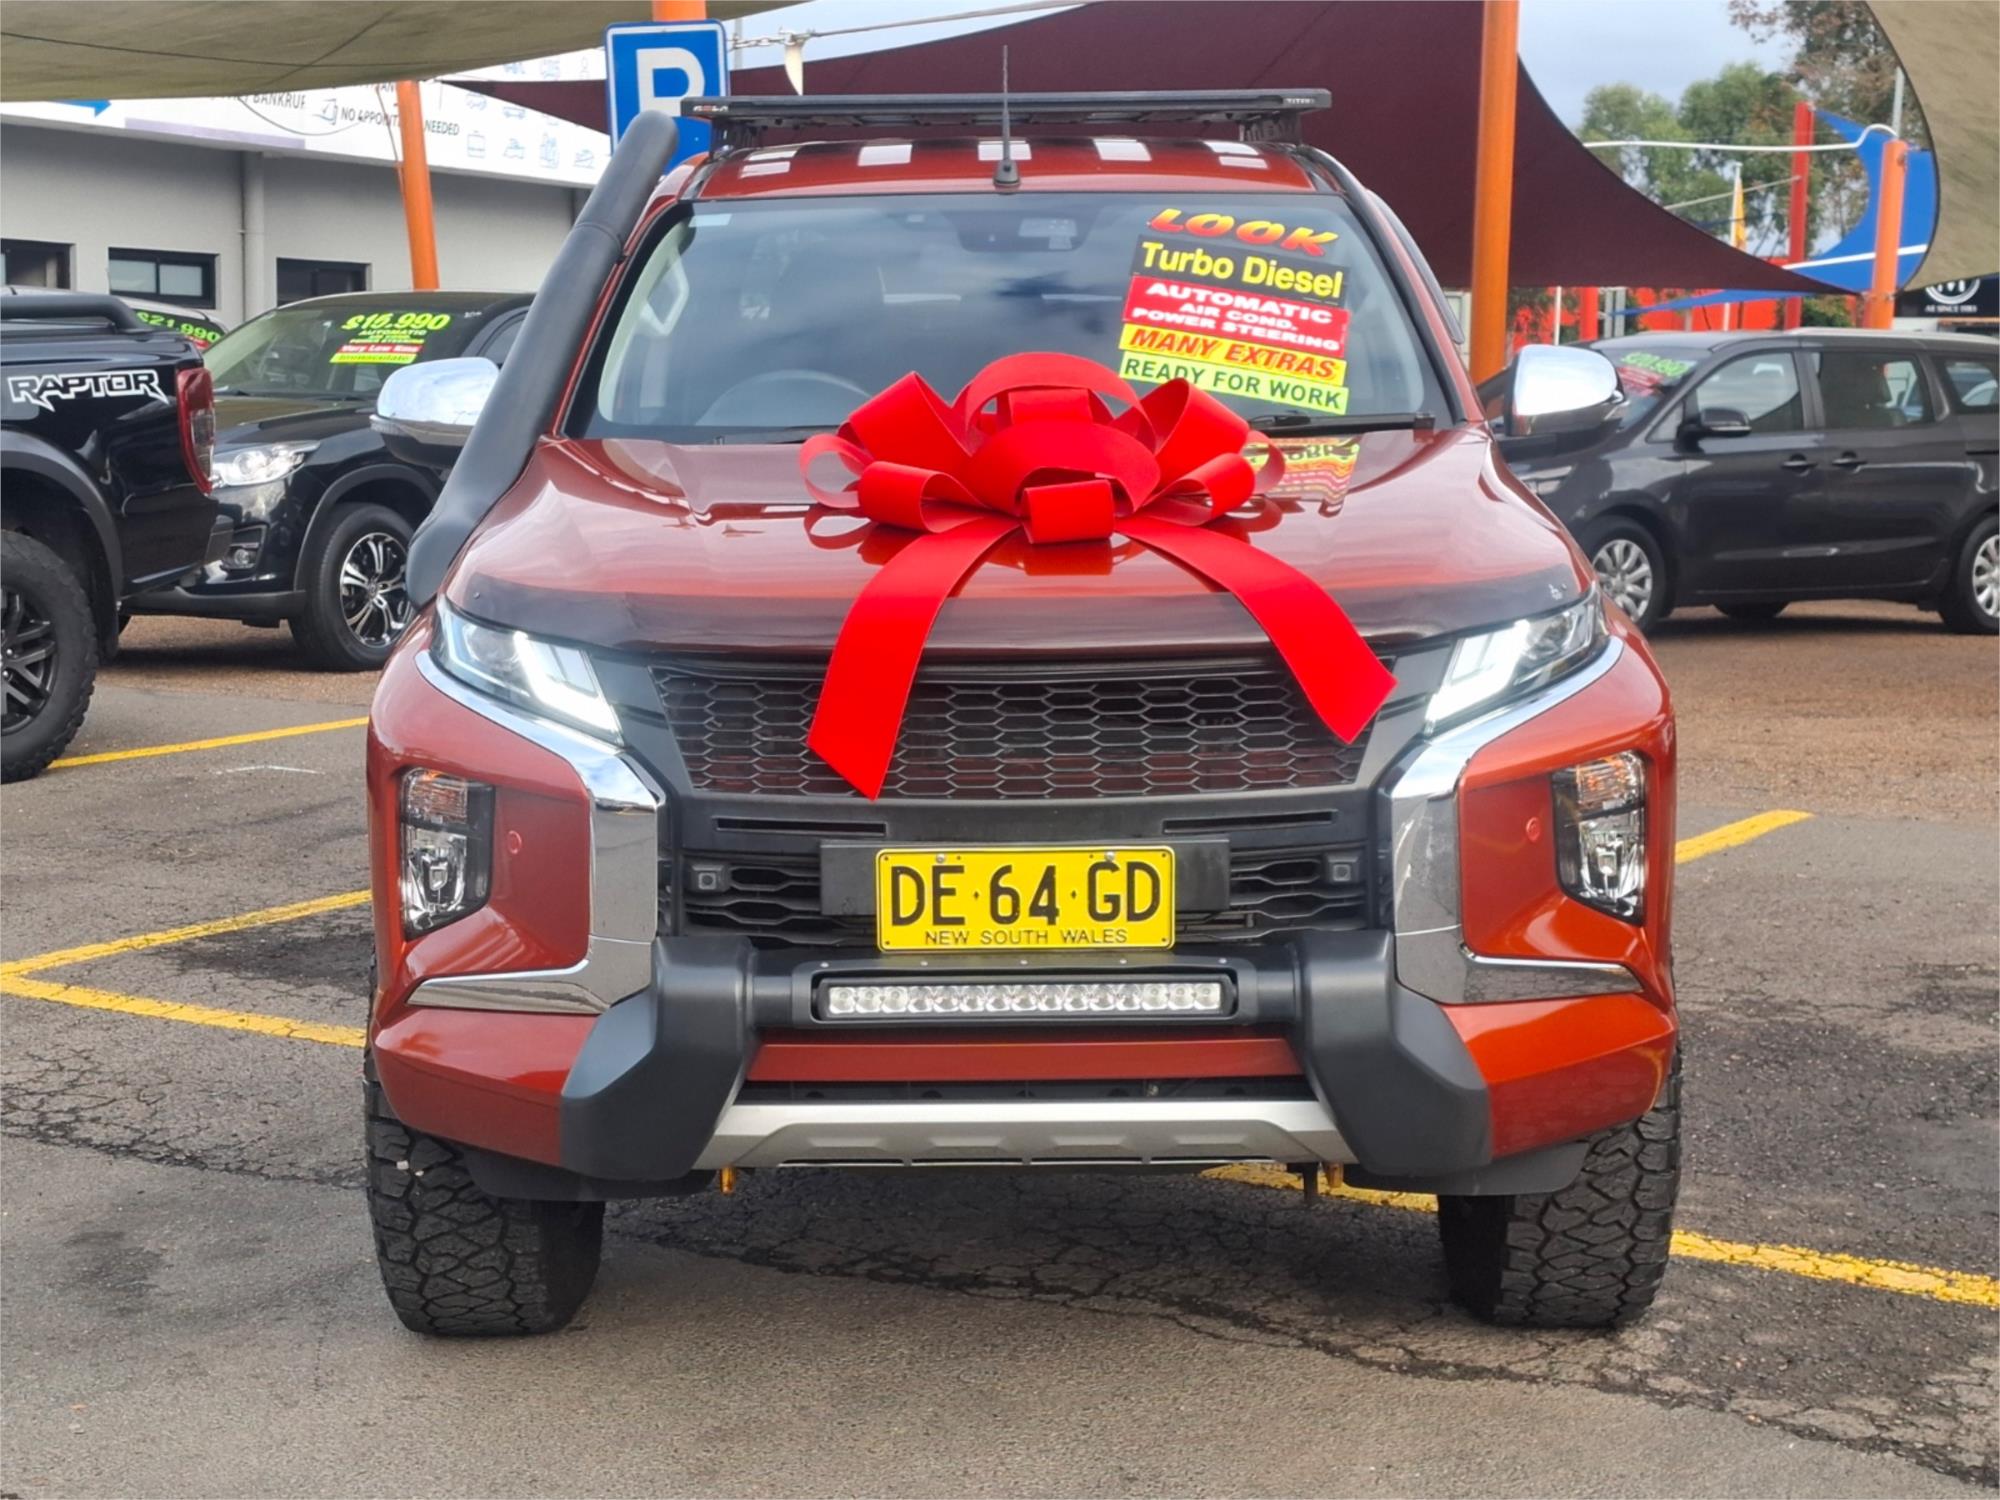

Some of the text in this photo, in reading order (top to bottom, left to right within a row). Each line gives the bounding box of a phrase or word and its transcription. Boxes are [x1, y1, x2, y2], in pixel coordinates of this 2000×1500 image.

[636, 47, 705, 117] P
[341, 107, 356, 121] NO
[425, 119, 460, 136] NEEDED
[1147, 208, 1339, 256] LOOK
[1142, 241, 1344, 298] Turbo Diesel
[1146, 282, 1333, 324] AUTOMATIC
[1179, 302, 1299, 331] AIR COND.
[1132, 306, 1340, 351] POWER STEERING
[1129, 328, 1339, 379] MANY EXTRAS
[8, 369, 170, 413] RAPTOR
[1124, 358, 1343, 409] READY FOR WORK
[891, 860, 1161, 927] DE 64 GD
[925, 928, 1128, 946] NEW SOUTH WALES
